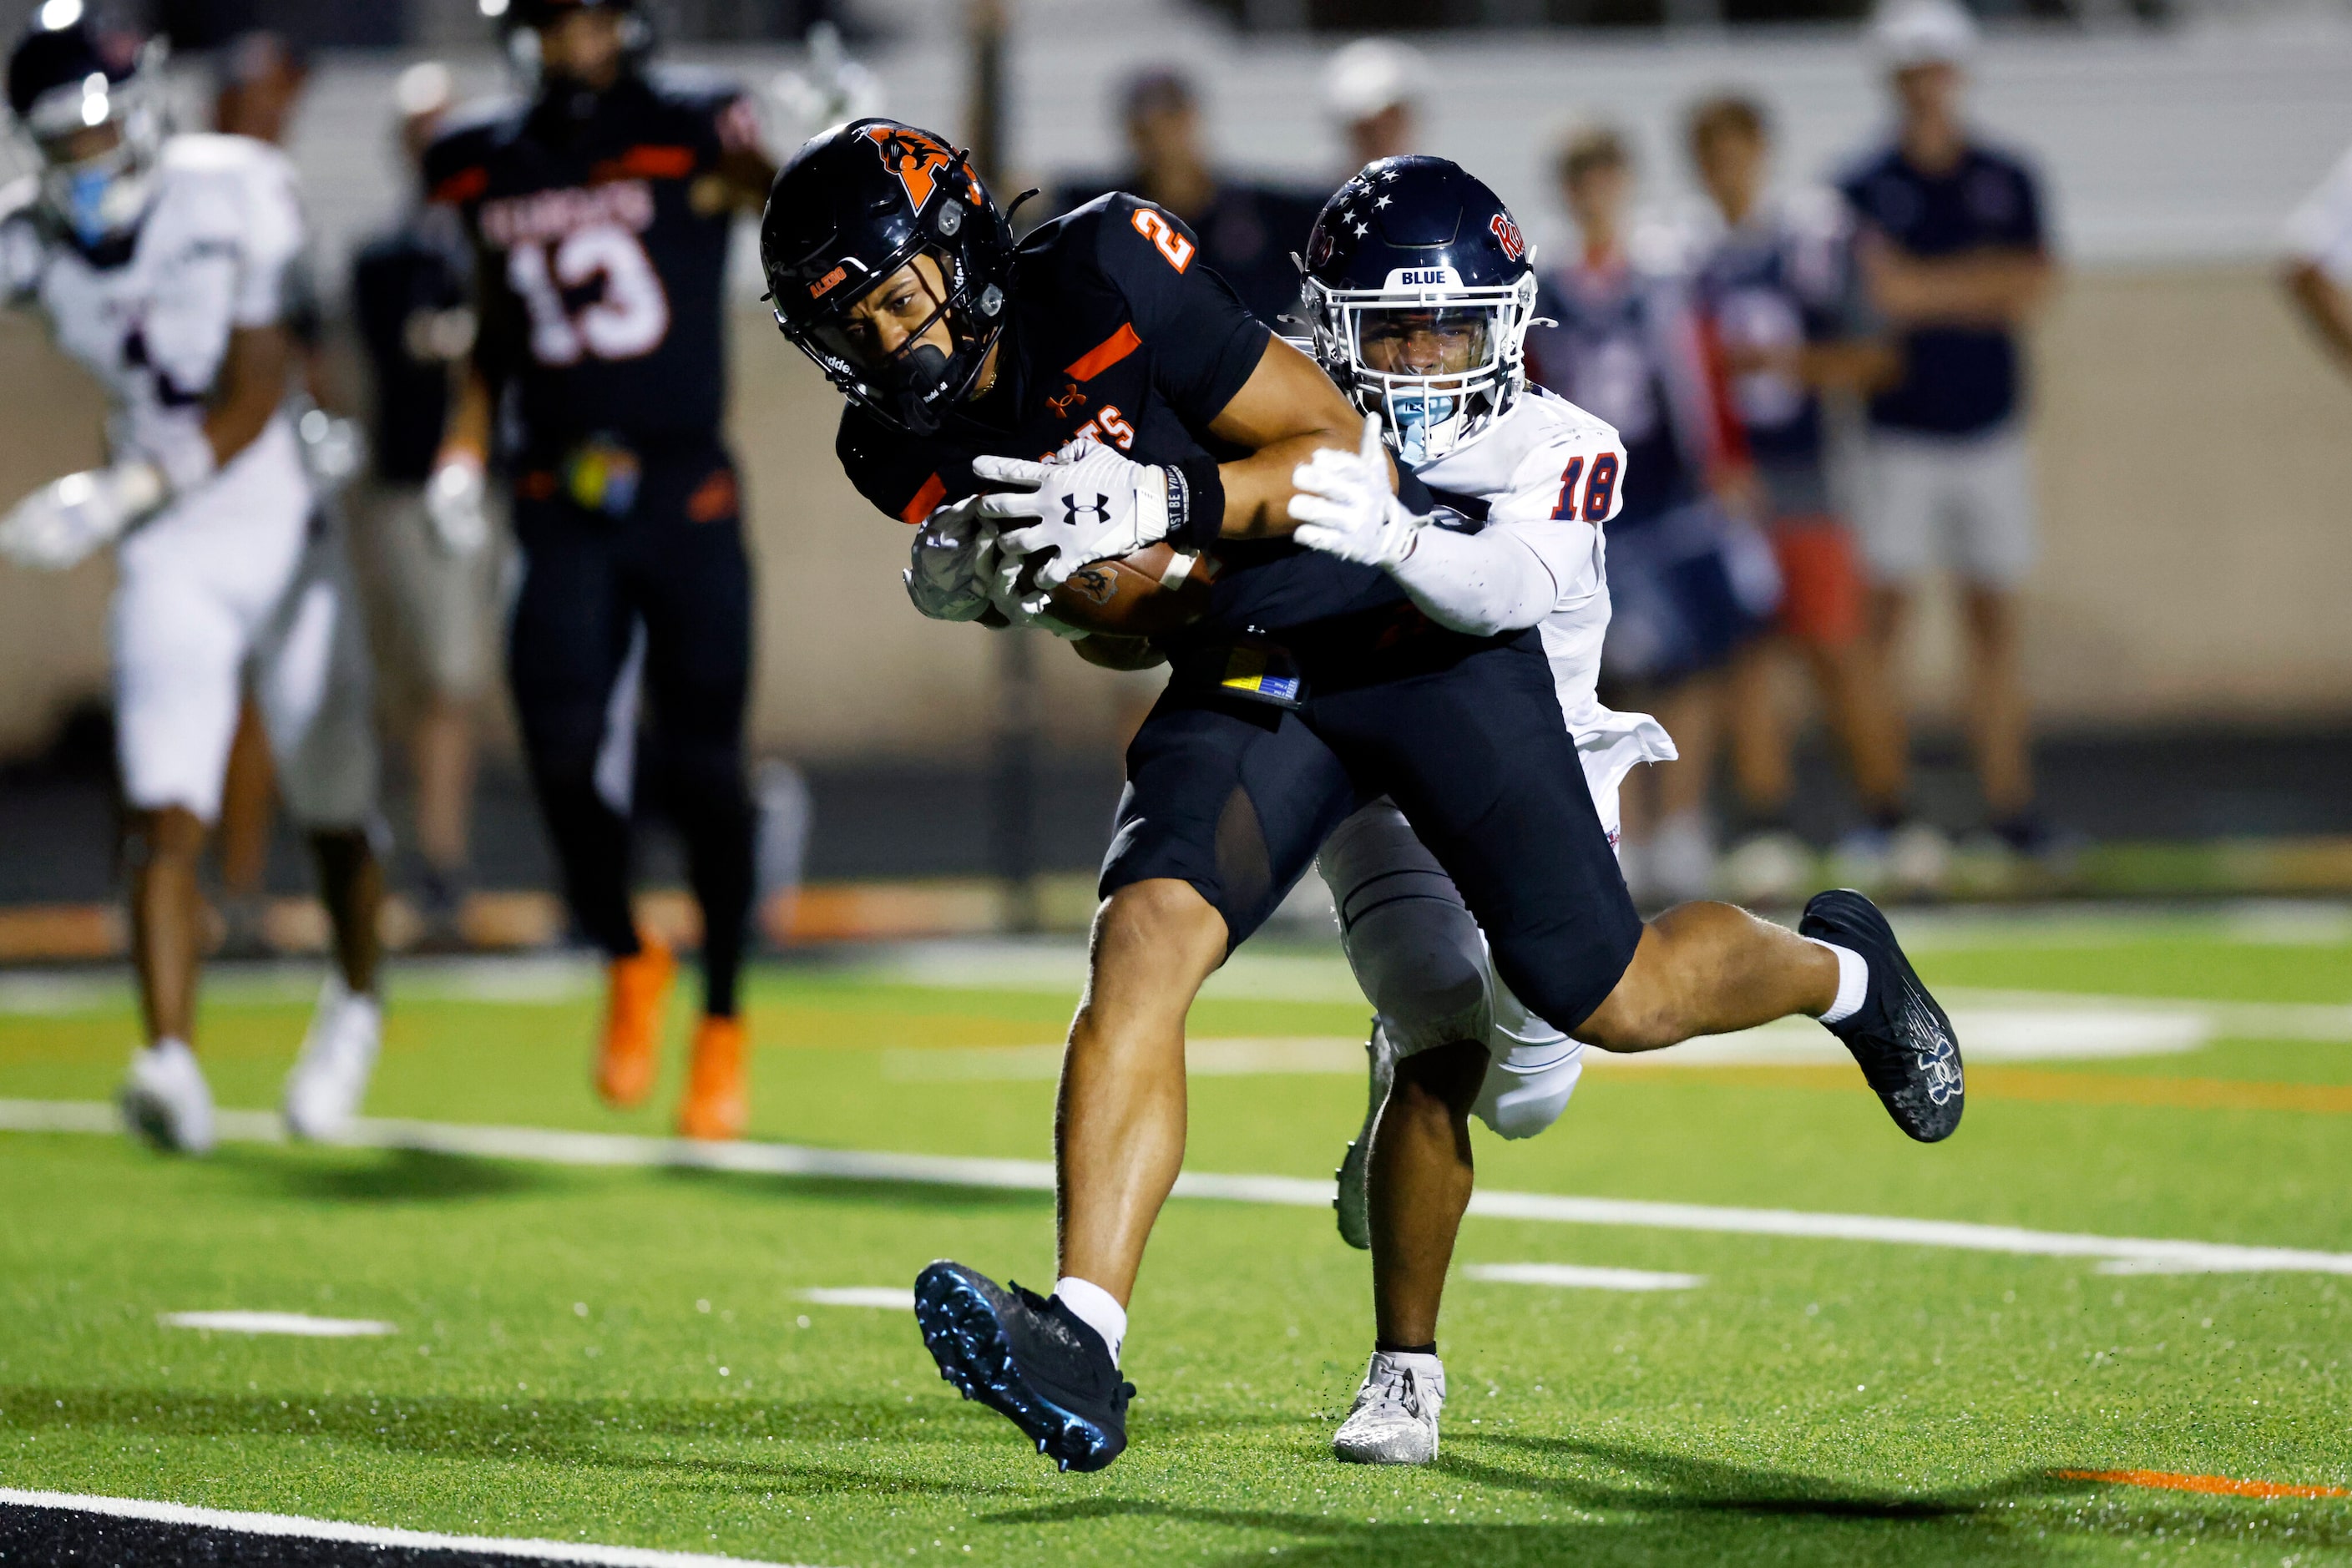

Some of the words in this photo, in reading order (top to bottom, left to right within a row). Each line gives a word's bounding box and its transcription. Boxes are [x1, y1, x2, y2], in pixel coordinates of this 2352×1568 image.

[1130, 208, 1196, 275] 2
[508, 224, 670, 365] 13
[810, 266, 847, 299] ALEDO
[1402, 271, 1445, 285] BLUE
[1549, 452, 1619, 522] 18
